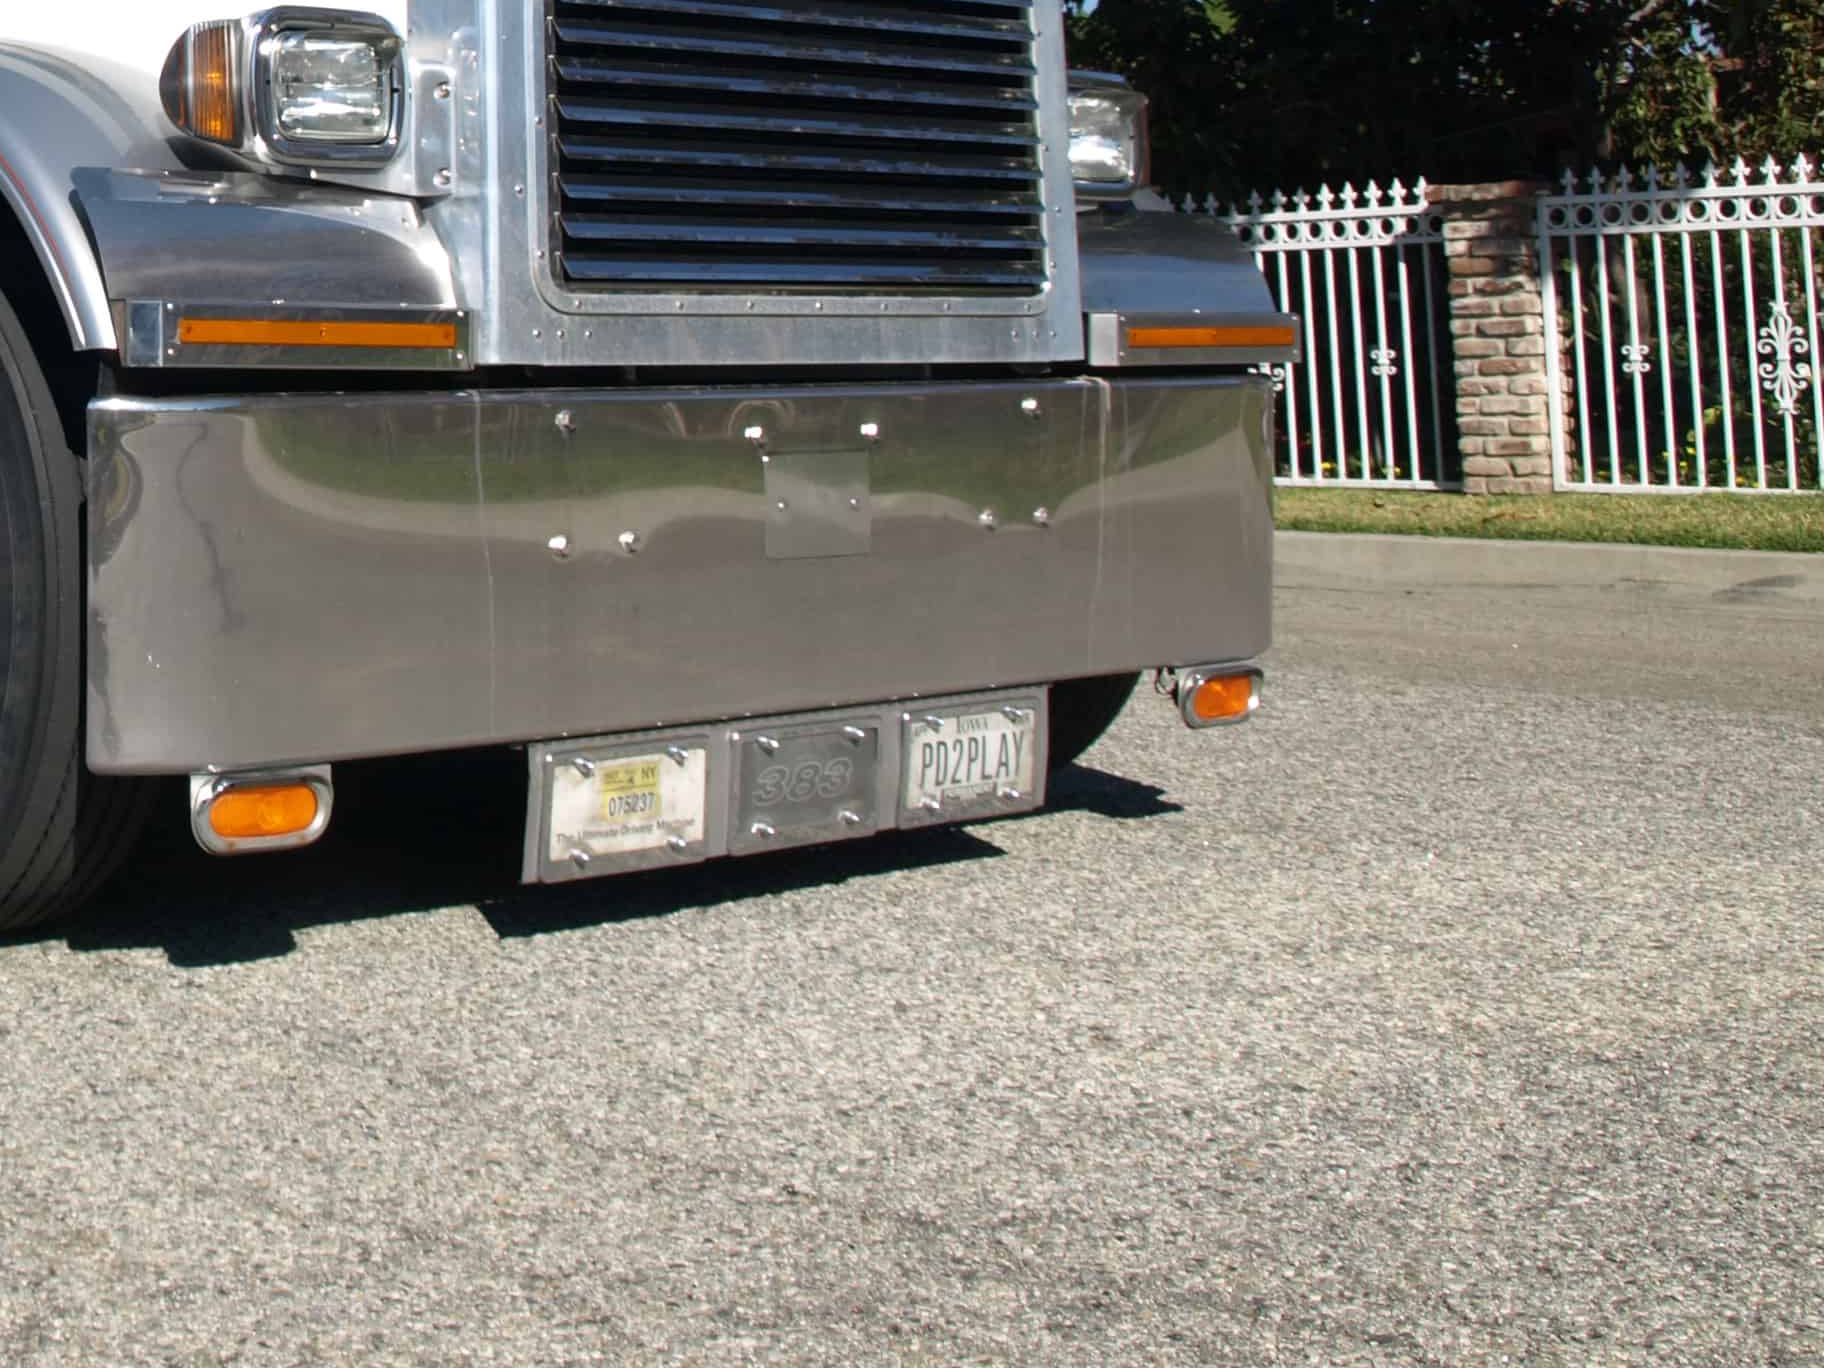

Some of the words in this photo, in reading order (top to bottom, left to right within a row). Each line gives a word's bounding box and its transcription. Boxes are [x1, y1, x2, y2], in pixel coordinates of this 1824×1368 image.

[752, 756, 854, 807] 383
[919, 731, 1025, 791] PD2PLAY
[608, 792, 657, 817] 075237
